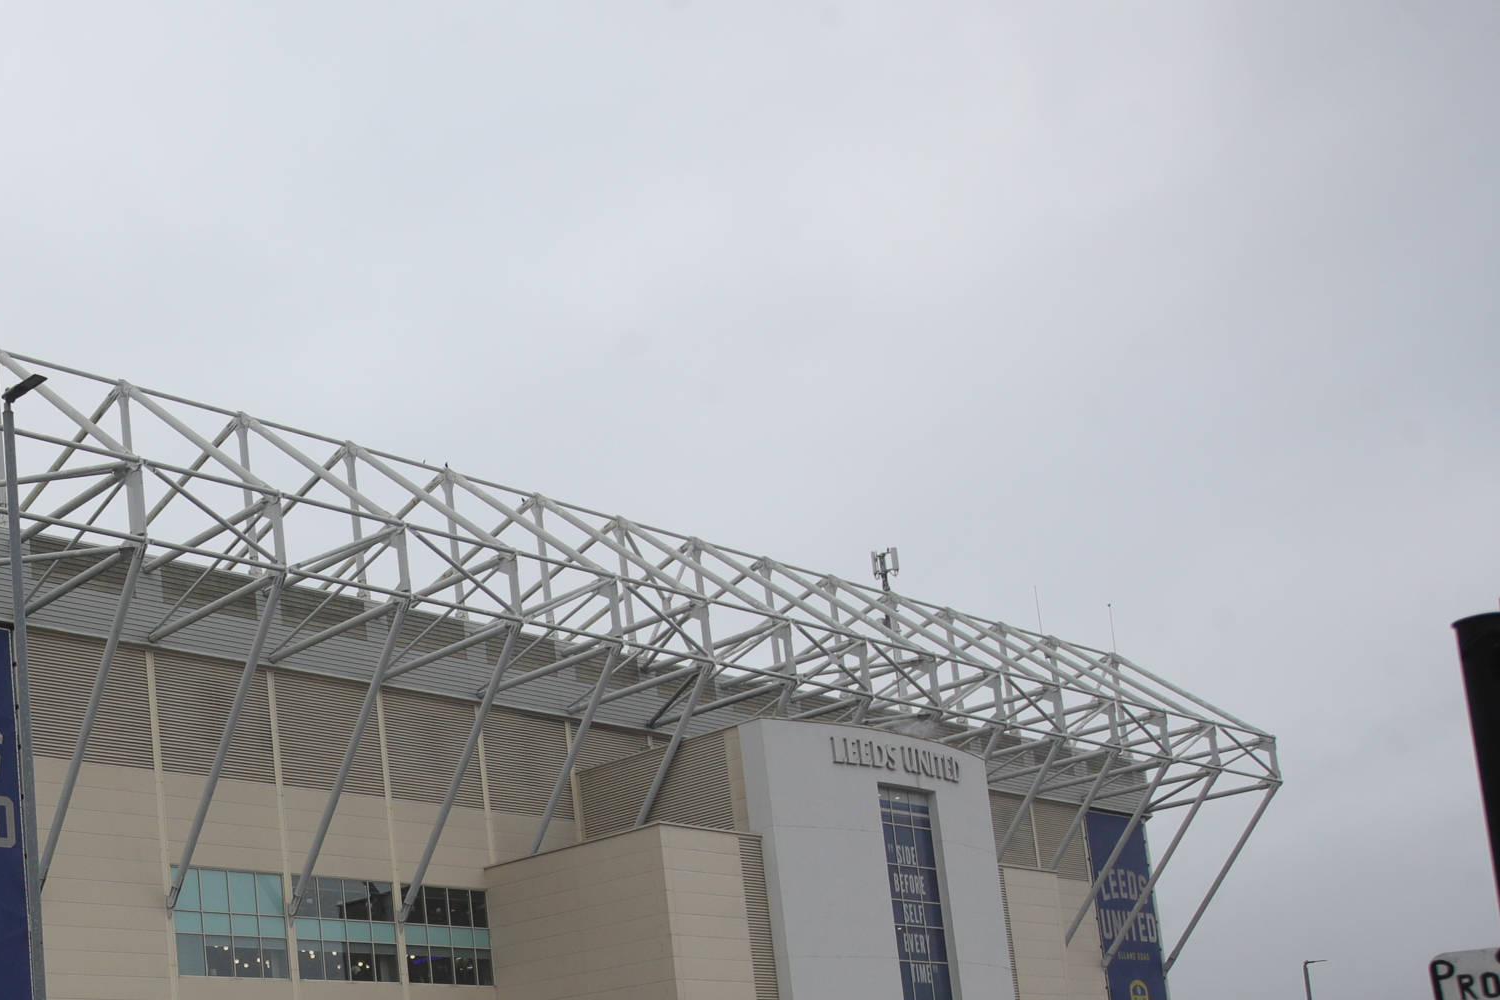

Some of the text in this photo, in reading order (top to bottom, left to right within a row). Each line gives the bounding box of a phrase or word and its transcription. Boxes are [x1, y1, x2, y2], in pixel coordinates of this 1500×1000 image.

[830, 736, 960, 784] LEEDS UNITED
[893, 873, 927, 895] BEFORE
[904, 903, 925, 924] SELF
[903, 933, 931, 954] EVERY
